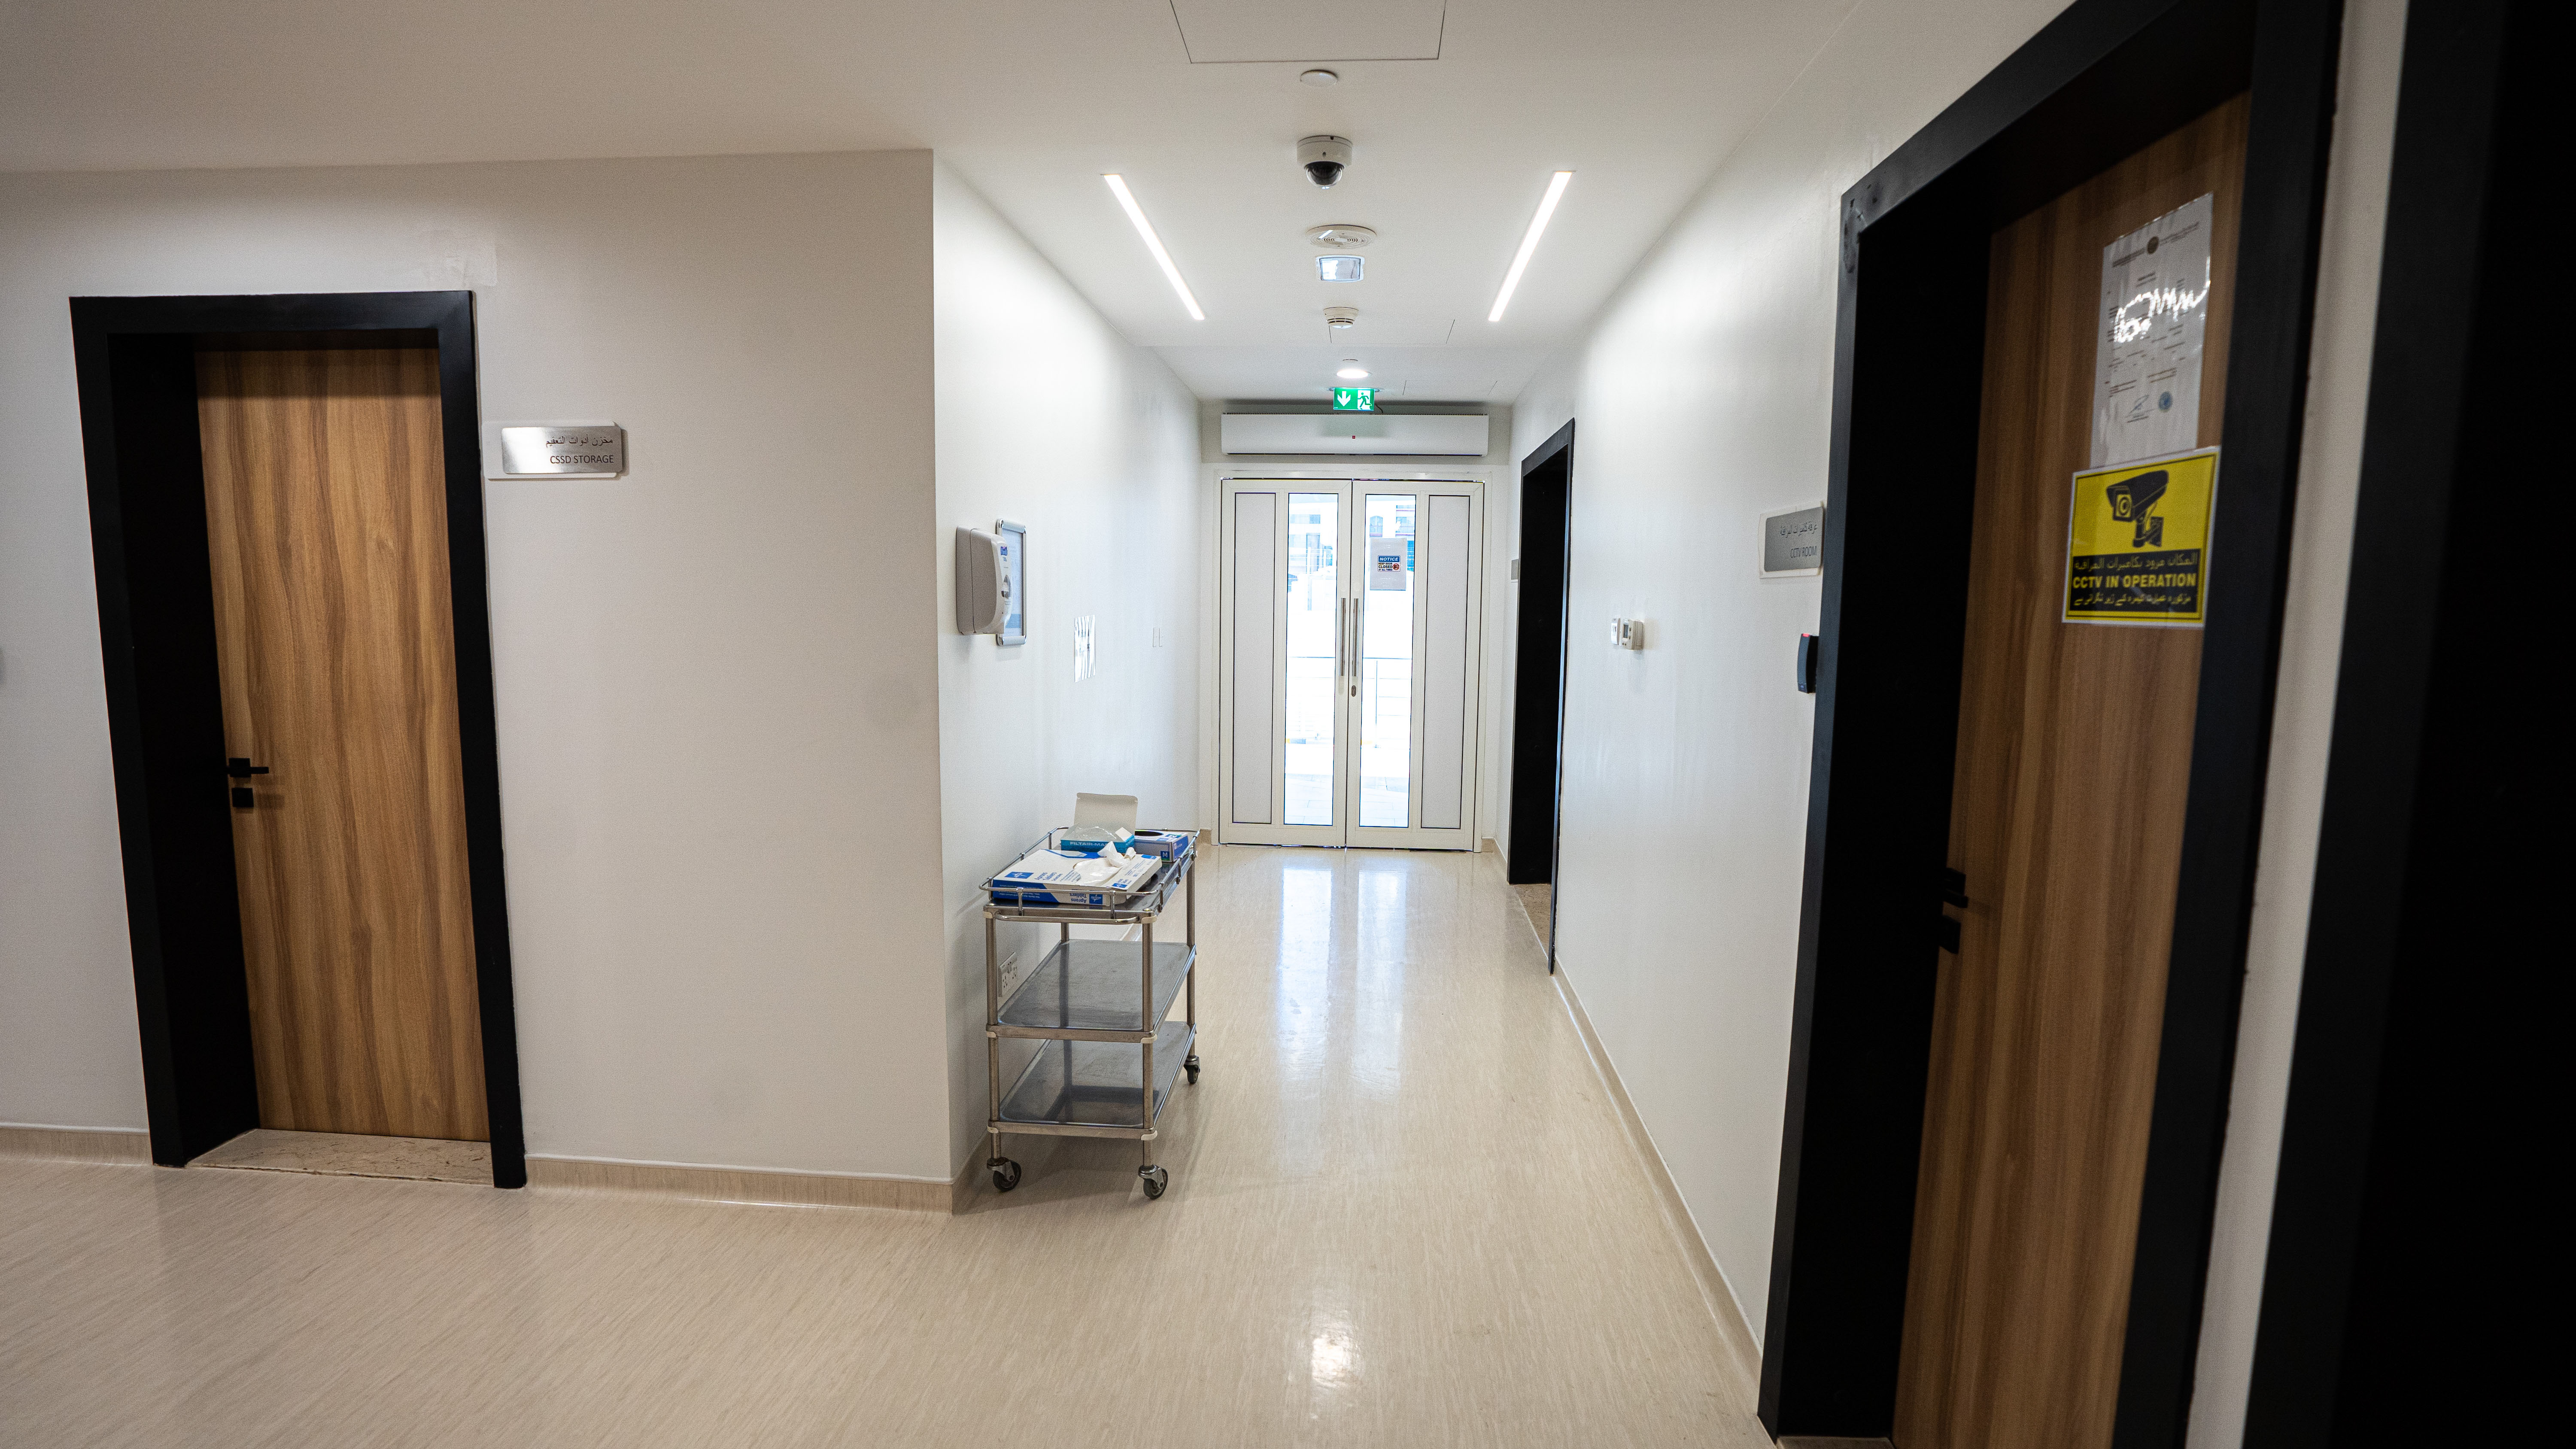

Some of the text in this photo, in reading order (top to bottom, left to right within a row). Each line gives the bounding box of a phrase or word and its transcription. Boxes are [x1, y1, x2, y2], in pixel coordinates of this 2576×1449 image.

[546, 434, 613, 448] مخزن أدوات التعقيم
[550, 455, 614, 464] CSSD STORAGE
[1803, 546, 1817, 557] ROOM
[2167, 552, 2198, 567] المكان
[2072, 573, 2196, 589] CCTV IN OPERATION
